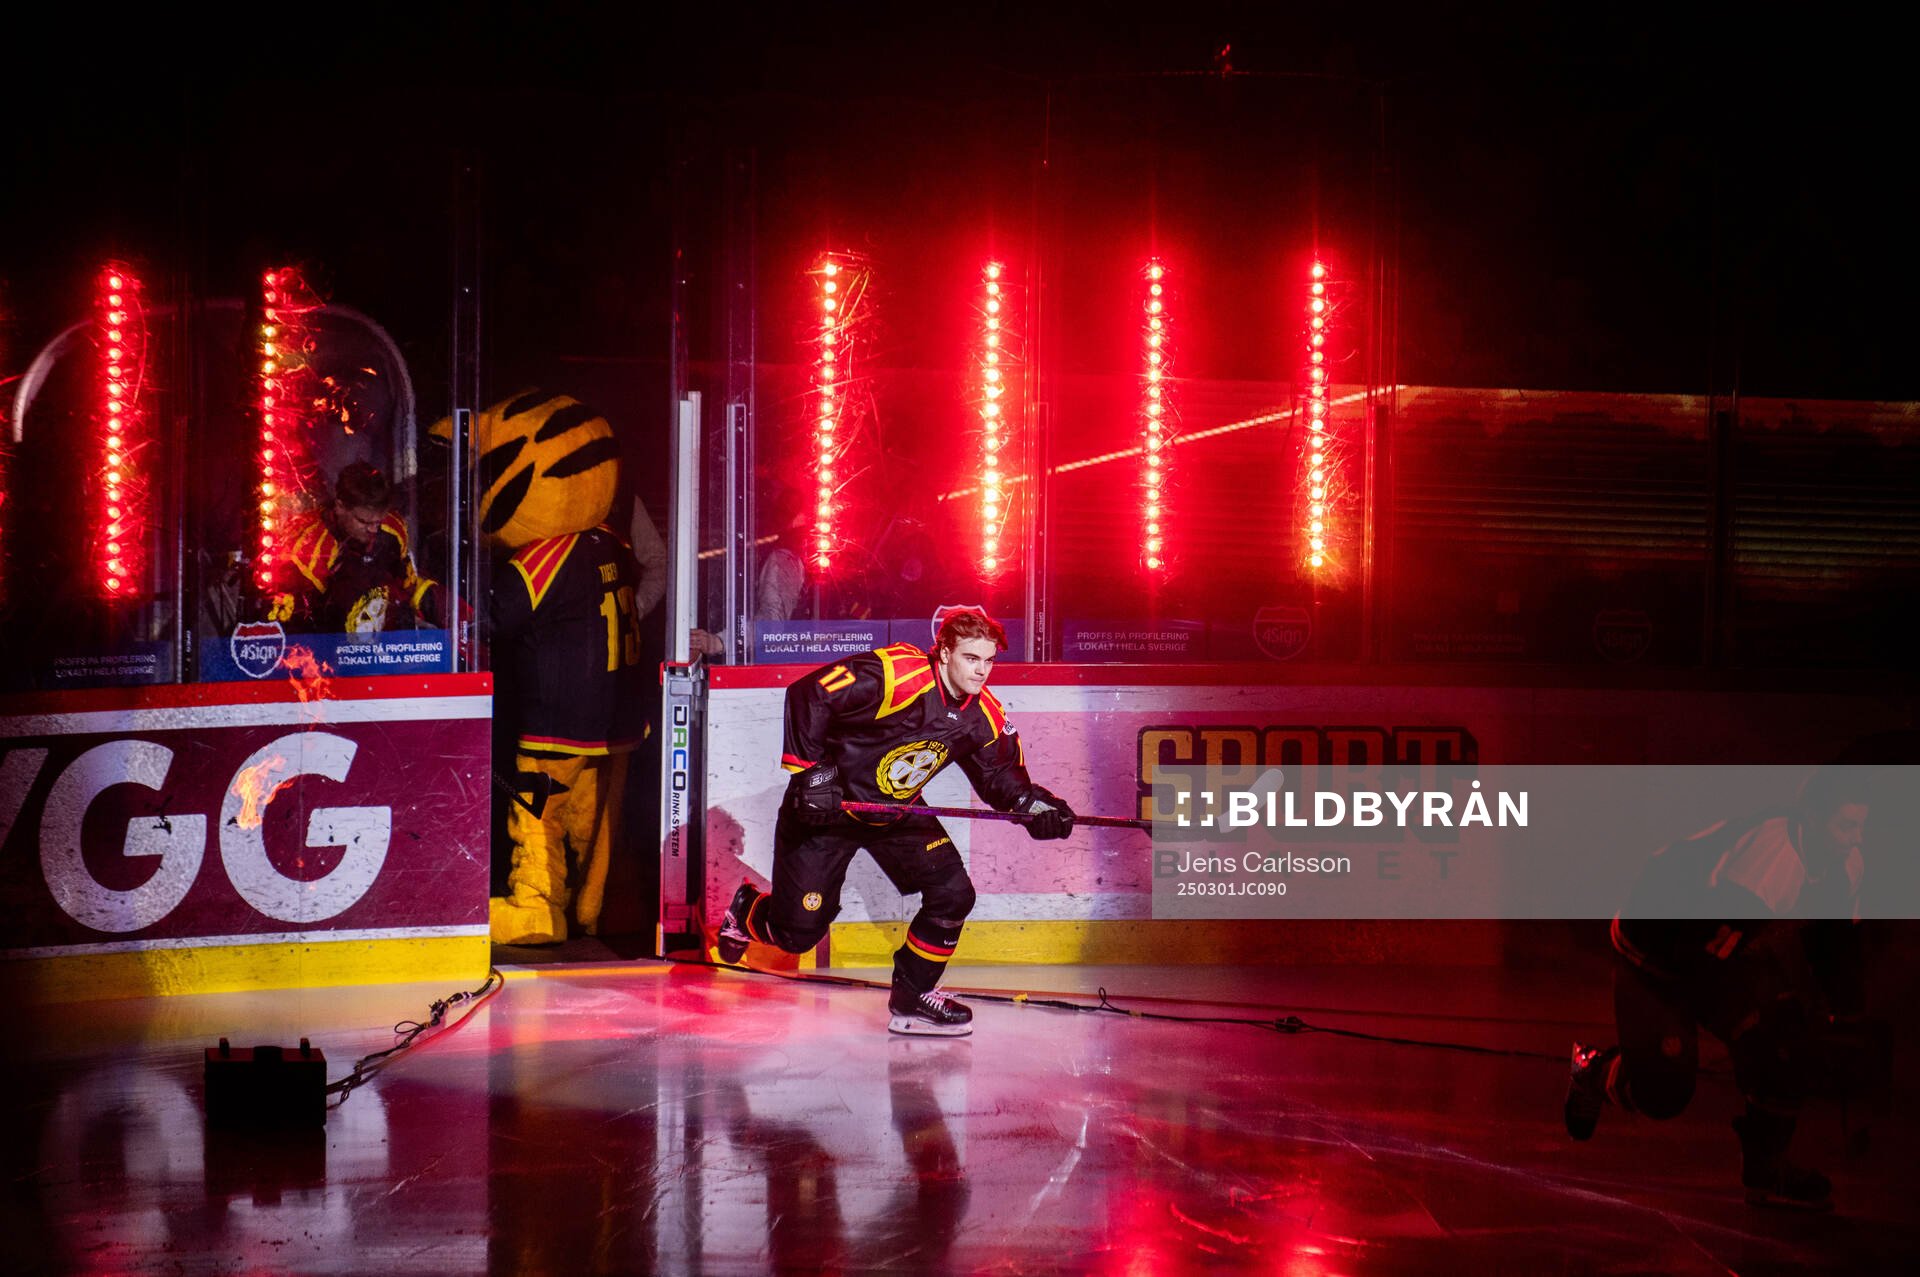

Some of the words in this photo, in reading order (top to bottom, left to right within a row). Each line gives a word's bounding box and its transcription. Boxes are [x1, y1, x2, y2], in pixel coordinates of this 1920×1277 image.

[762, 633, 798, 642] PROFFS
[801, 631, 812, 642] PÅ
[814, 632, 874, 642] PROFILERING
[1077, 631, 1113, 640] PROFFS
[1128, 631, 1190, 641] PROFILERING
[337, 645, 371, 654] PROFFS
[373, 642, 384, 652] PÅ
[386, 642, 443, 651] PROFILERING
[764, 644, 800, 653] LOKALT
[807, 644, 830, 653] HELA
[832, 644, 871, 652] SVERIGE
[1079, 642, 1113, 651] LOKALT
[1148, 642, 1187, 651] SVERIGE
[239, 642, 277, 664] 4Sign
[338, 655, 373, 665] LOKALT
[379, 654, 402, 663] HELA
[404, 653, 441, 662] SVERIGE
[817, 664, 857, 694] 17
[672, 706, 688, 791] DACO
[927, 740, 945, 753] 1912
[671, 792, 680, 857] RINK-SYSTEM
[0, 731, 392, 933] GG
